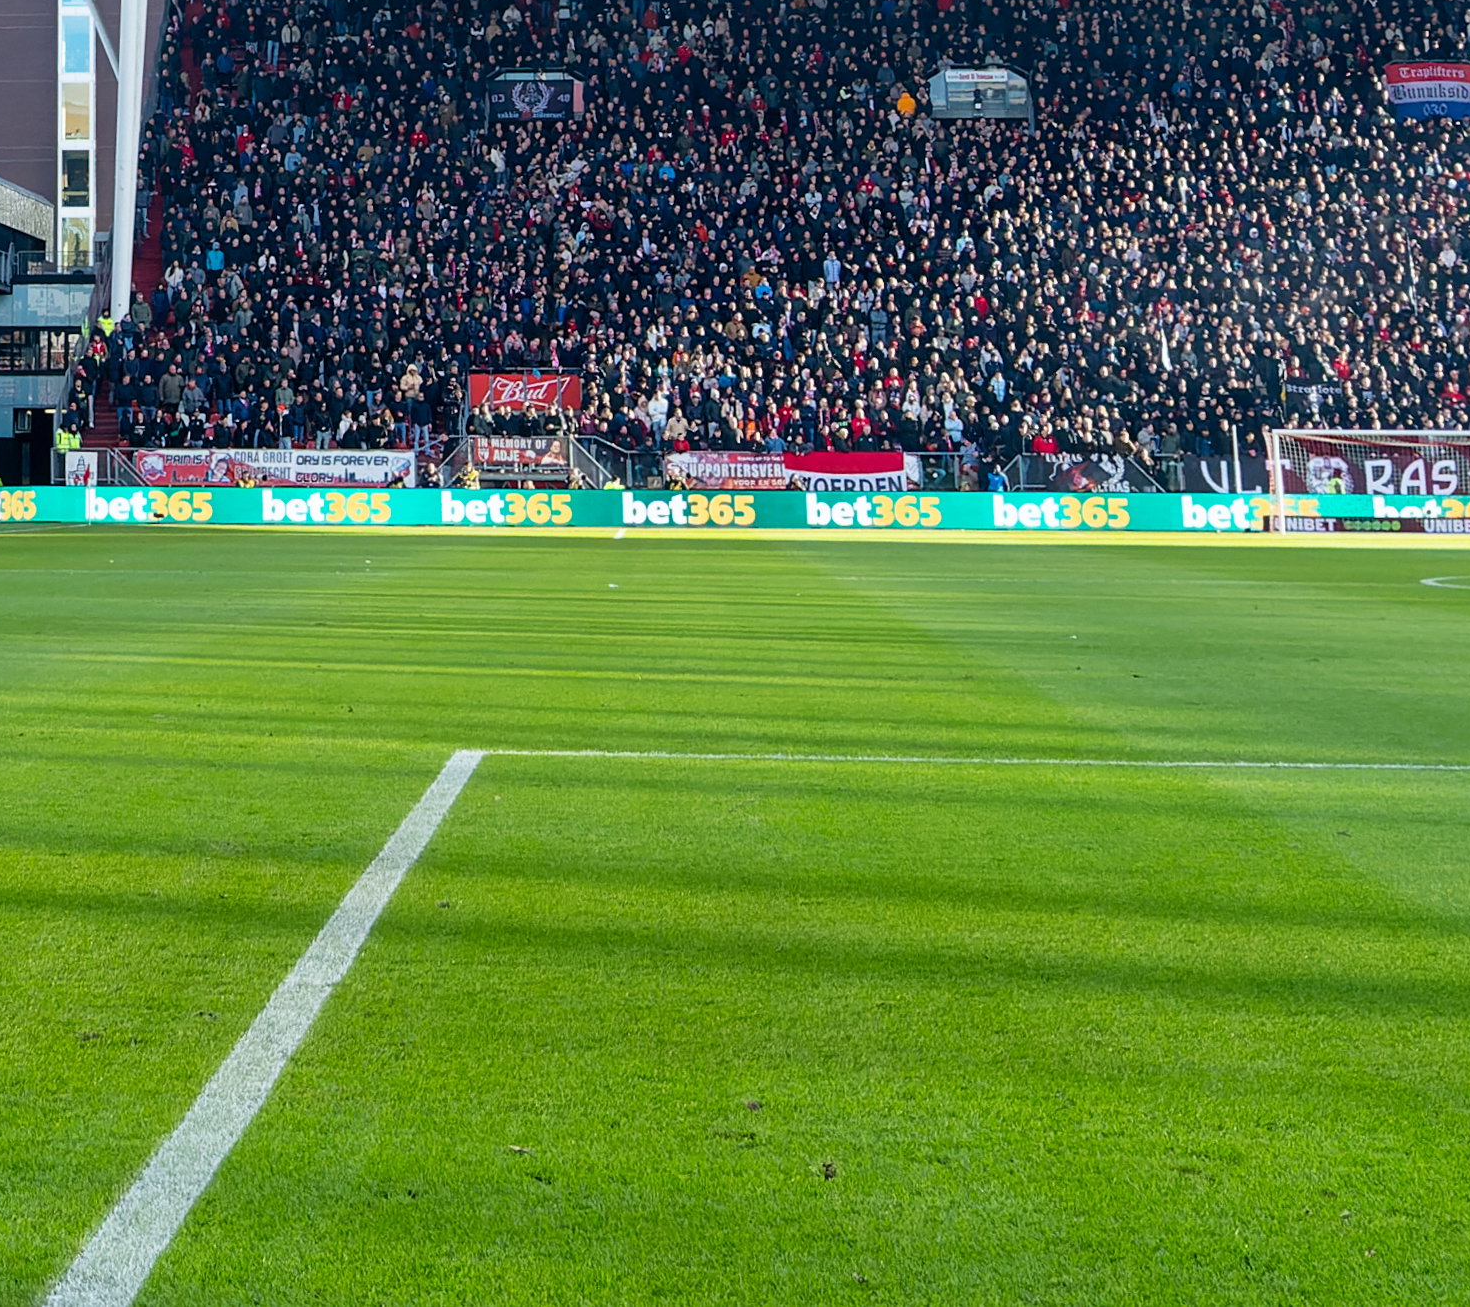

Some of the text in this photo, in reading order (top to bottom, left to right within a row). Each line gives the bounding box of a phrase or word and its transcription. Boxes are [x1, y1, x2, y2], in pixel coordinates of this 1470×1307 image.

[1398, 66, 1466, 79] Traplifters
[1422, 103, 1448, 116] 030
[499, 380, 547, 401] Bud
[477, 438, 547, 451] IN MEMORY OF
[166, 454, 191, 466] PAIN
[192, 454, 202, 466] IS
[234, 451, 293, 464] CORA GROET
[321, 455, 332, 466] IS
[333, 455, 389, 466] FOREVER
[493, 449, 520, 462] ADJE
[86, 490, 213, 522] bet365
[262, 489, 392, 523] bet365
[441, 491, 573, 525] bet365
[622, 492, 756, 526] bet365
[806, 493, 942, 527] bet365
[993, 494, 1131, 529] bet365
